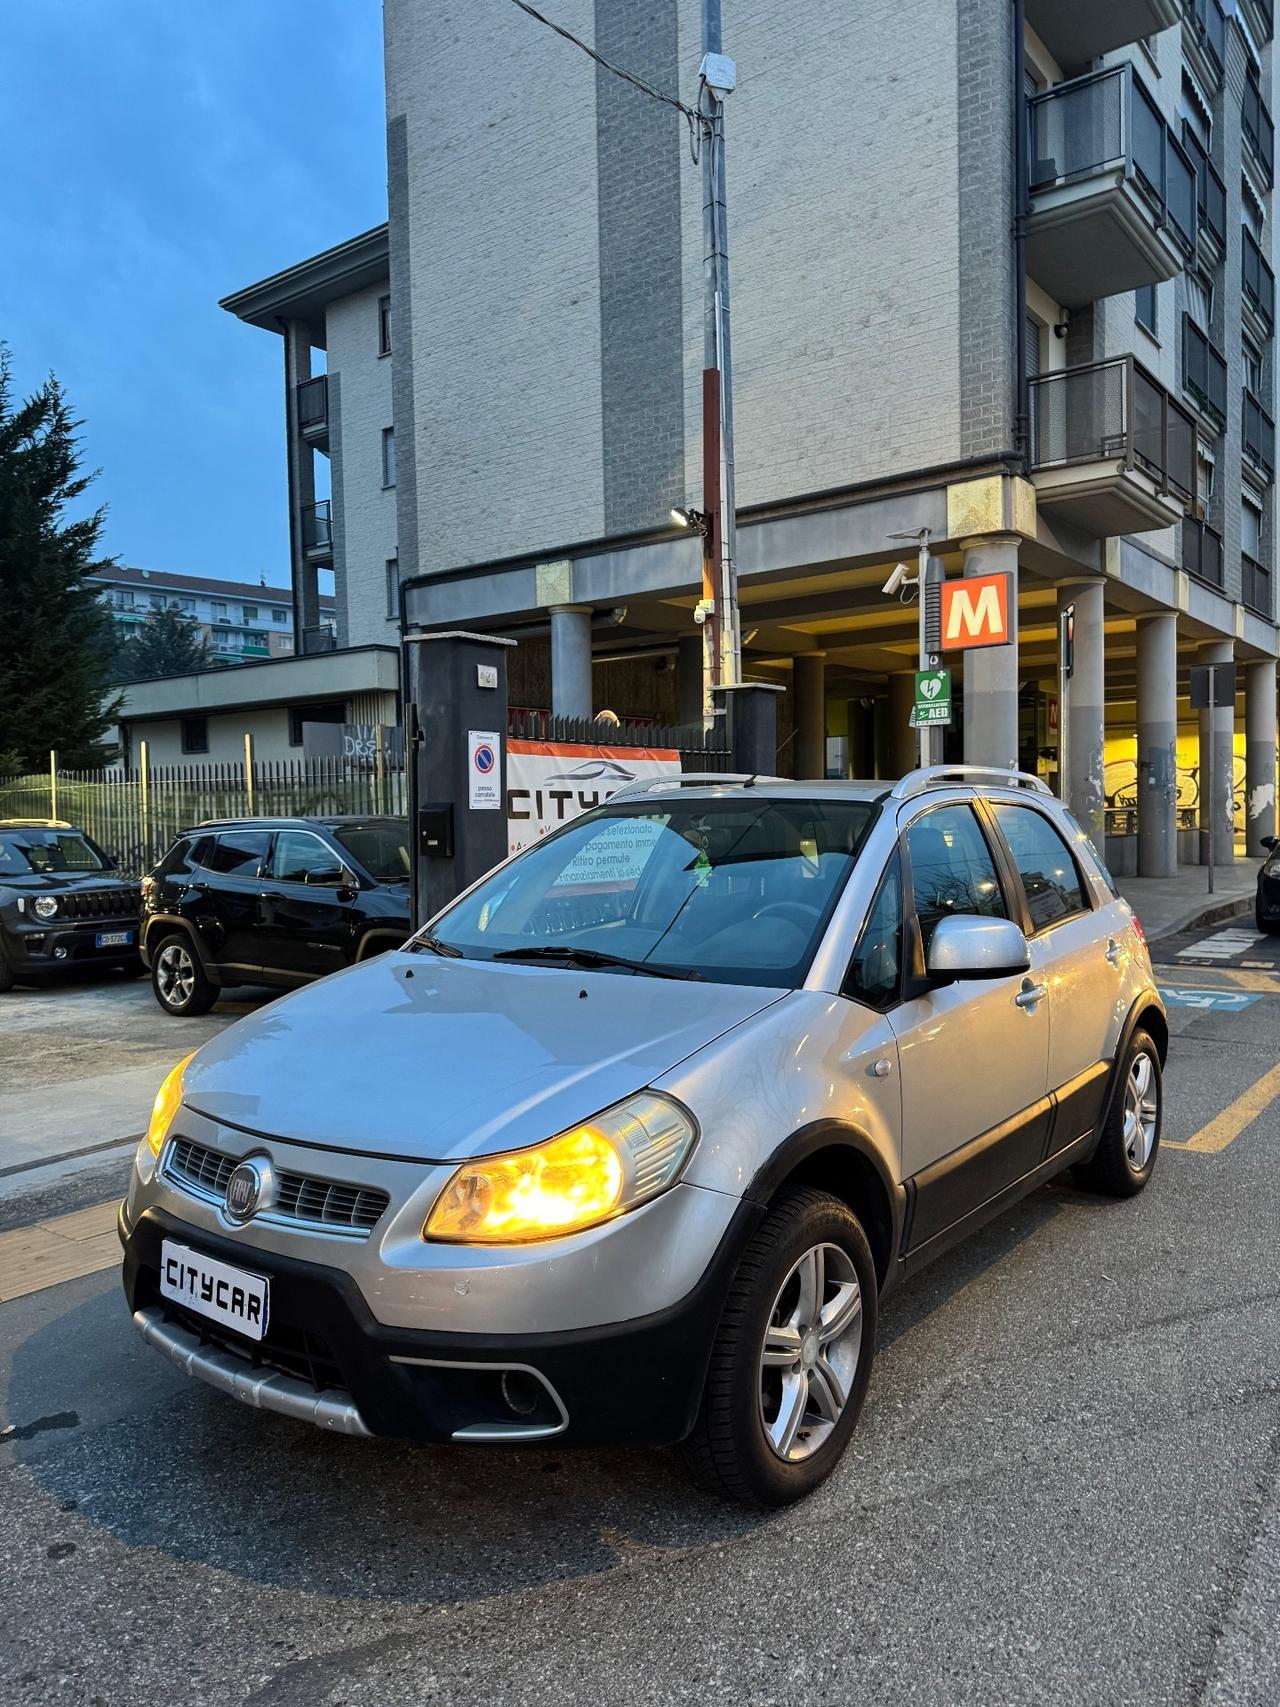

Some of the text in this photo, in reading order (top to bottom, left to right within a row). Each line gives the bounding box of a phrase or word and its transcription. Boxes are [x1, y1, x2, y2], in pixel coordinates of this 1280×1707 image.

[946, 585, 1003, 639] M
[928, 708, 949, 719] AED
[507, 789, 615, 820] CITY
[606, 823, 653, 836] selezionato
[585, 837, 634, 854] pagamento
[572, 853, 631, 869] Ritiro permute
[231, 1179, 253, 1203] FIAT
[166, 1258, 261, 1325] CITYCAR
